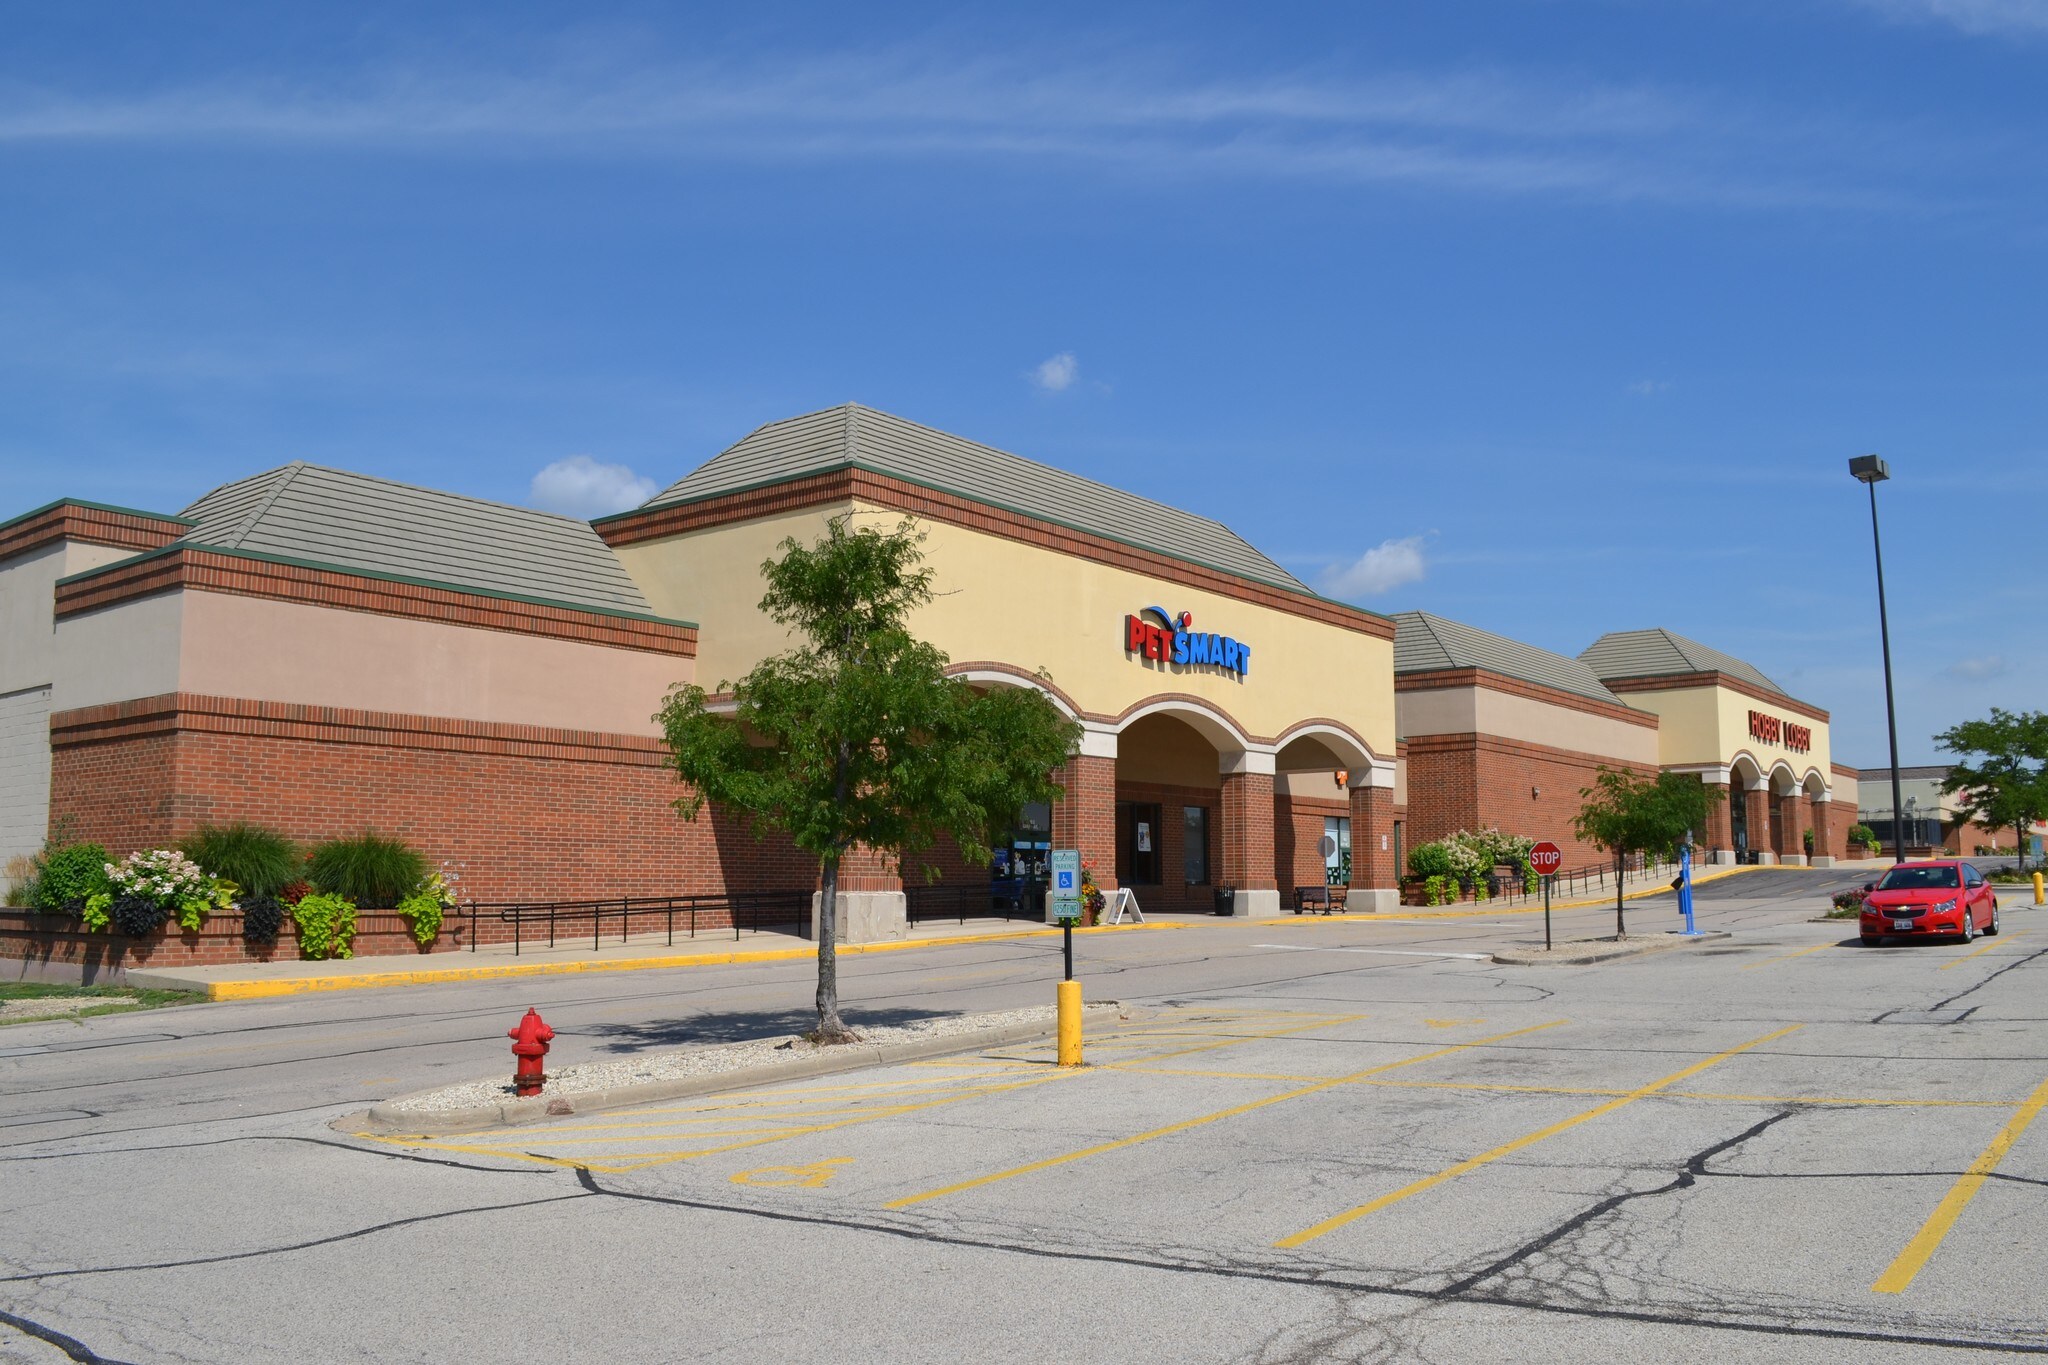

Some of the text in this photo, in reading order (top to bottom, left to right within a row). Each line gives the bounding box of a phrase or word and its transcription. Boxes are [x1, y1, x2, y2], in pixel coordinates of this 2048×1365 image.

[1748, 710, 1812, 752] HOBBY LOBBY
[1053, 854, 1077, 862] RESERVED
[1531, 851, 1560, 865] STOP
[1066, 904, 1077, 914] FINE
